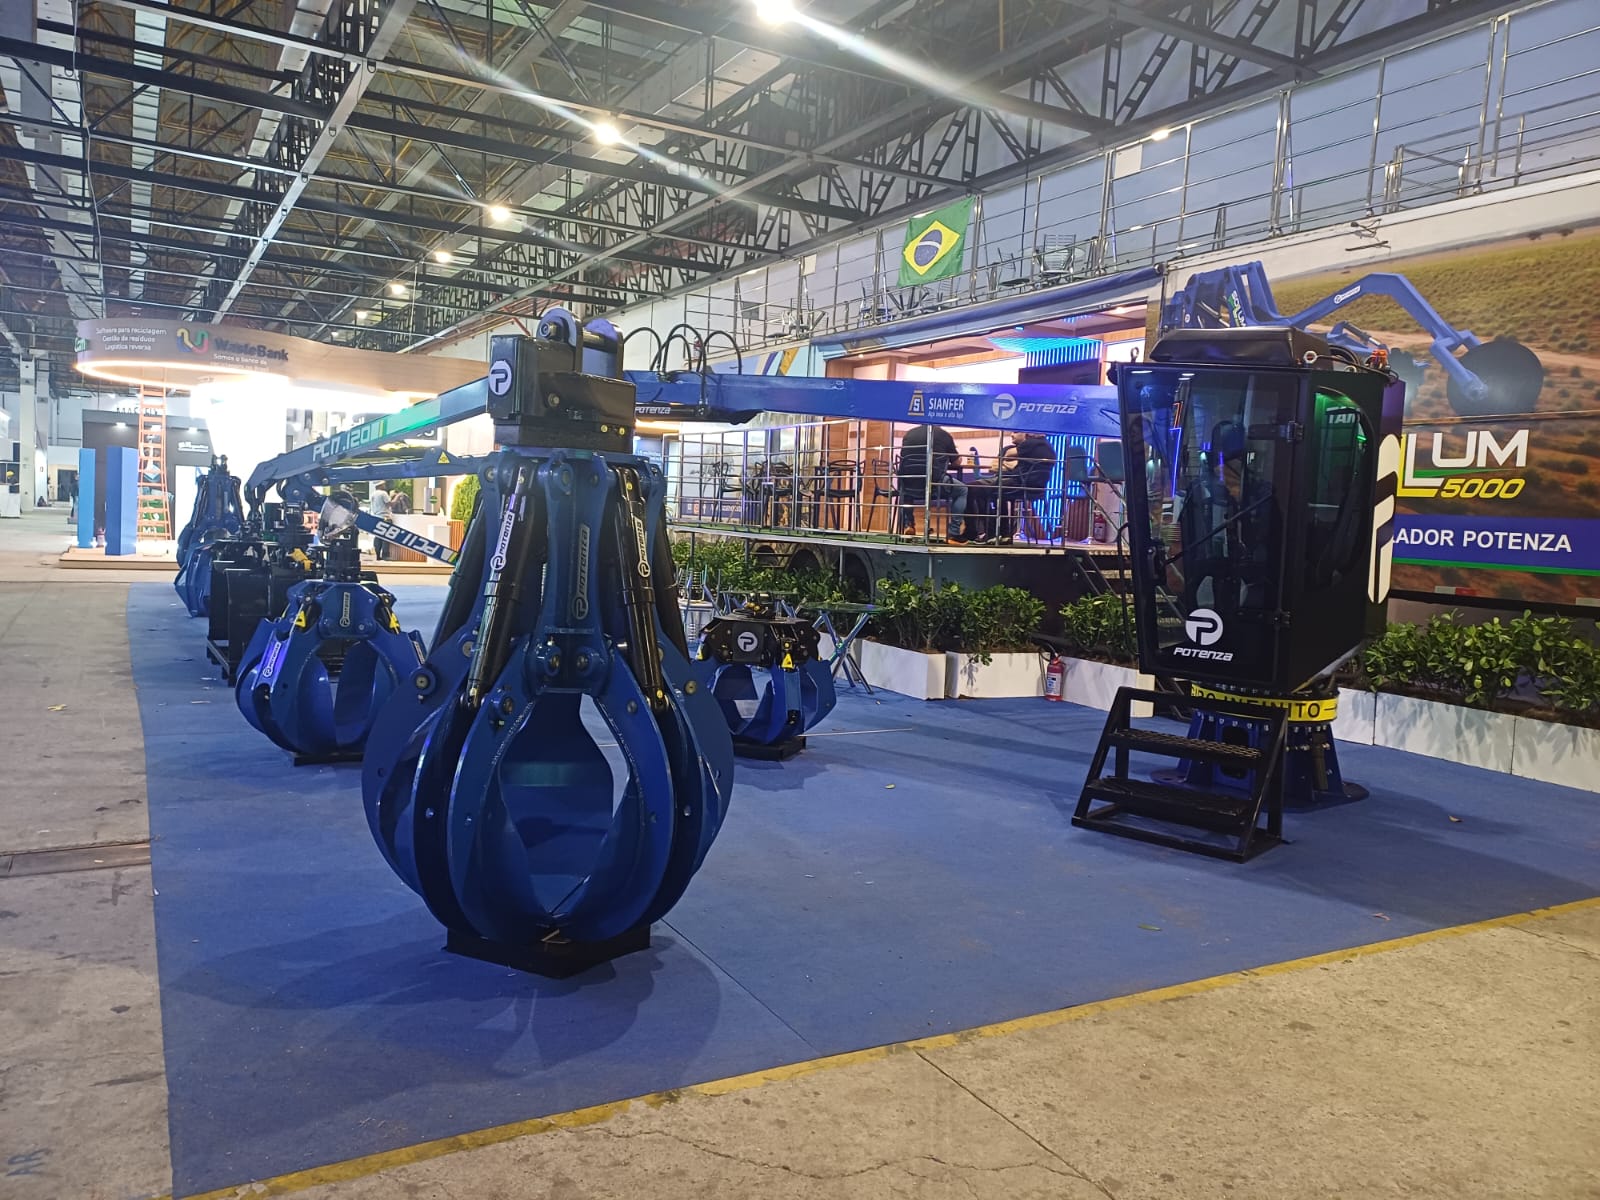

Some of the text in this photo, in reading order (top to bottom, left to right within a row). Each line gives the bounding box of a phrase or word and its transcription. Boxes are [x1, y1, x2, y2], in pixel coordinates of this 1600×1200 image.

[928, 397, 965, 411] SIANFER
[1440, 478, 1527, 499] 5000
[1462, 530, 1573, 553] POTENZA
[1173, 647, 1234, 662] POTENZA
